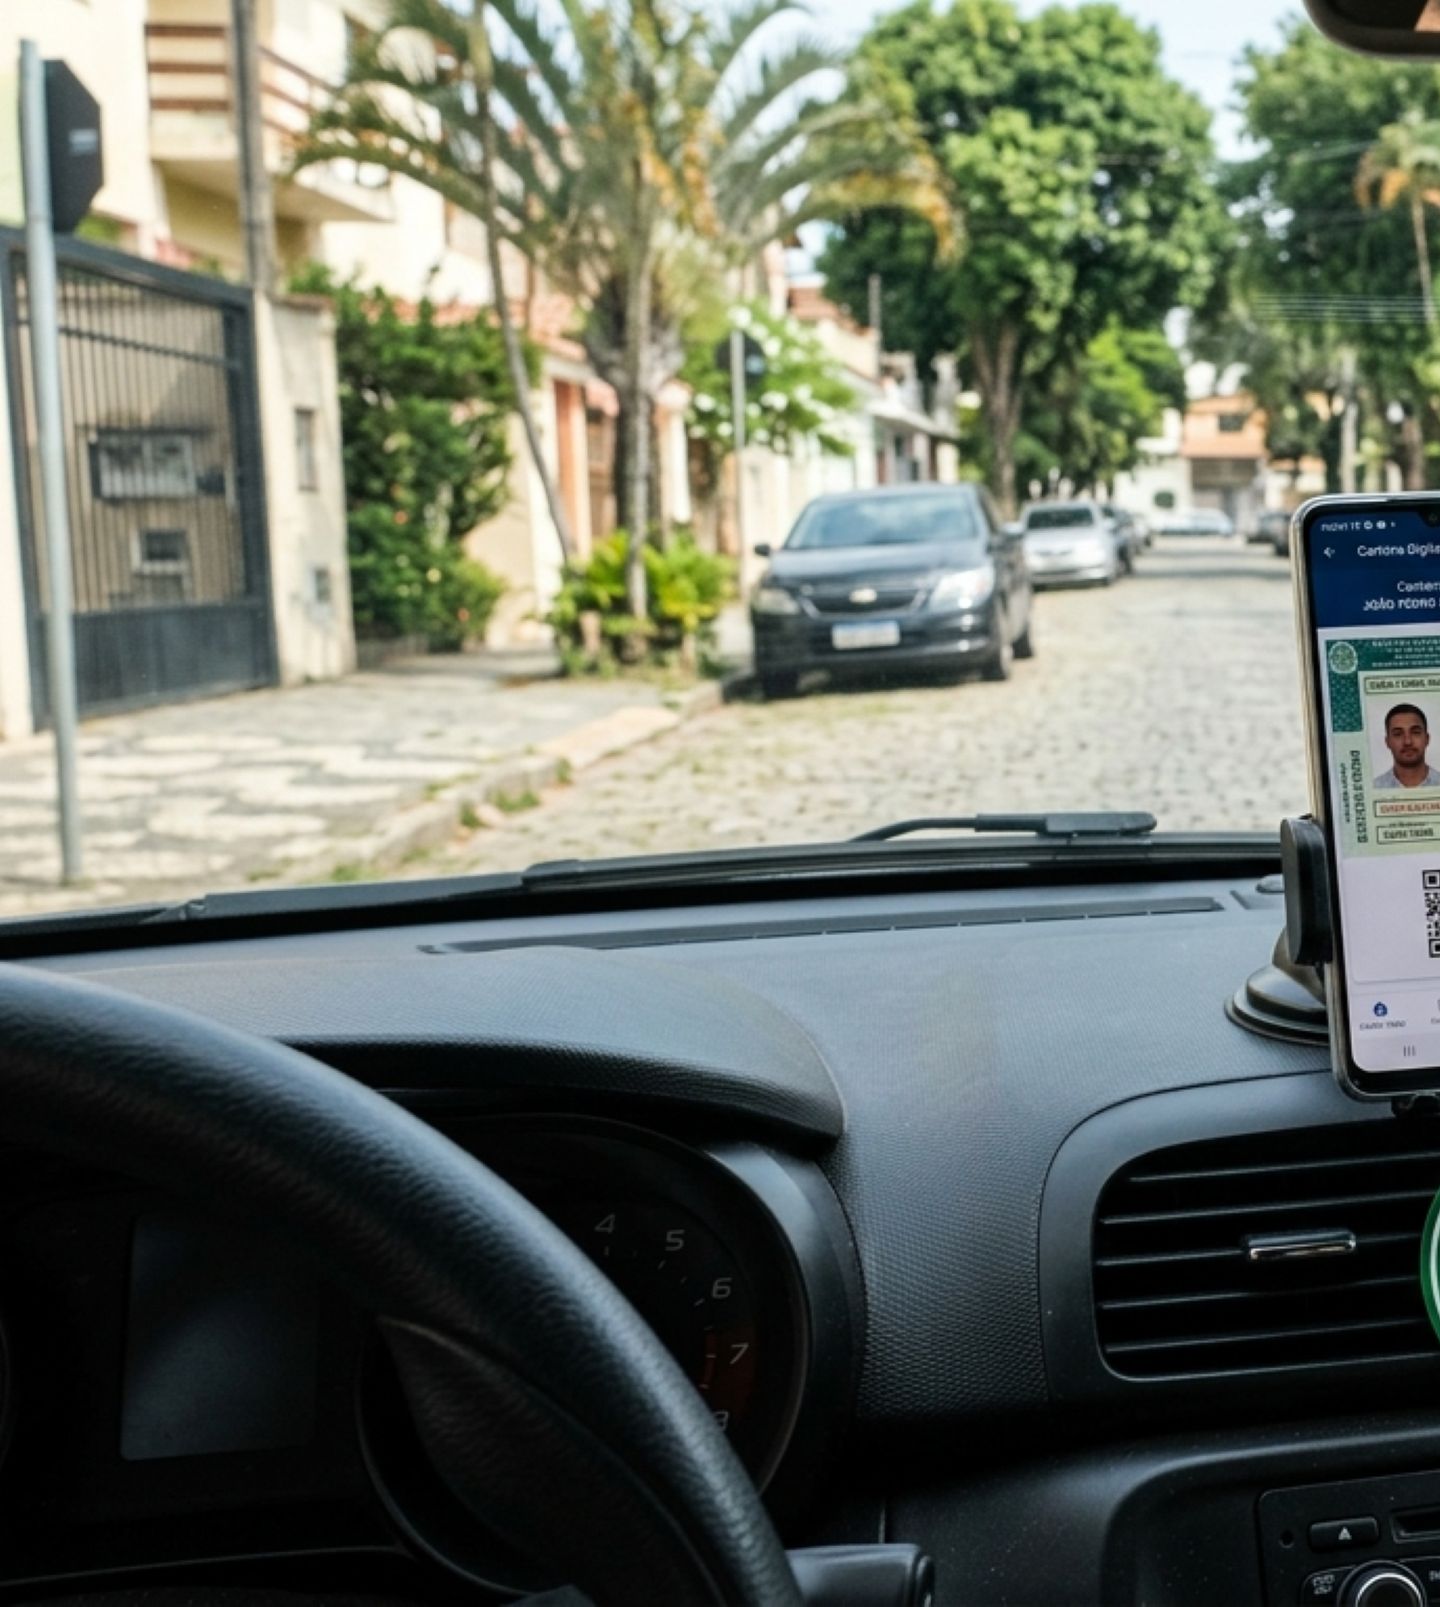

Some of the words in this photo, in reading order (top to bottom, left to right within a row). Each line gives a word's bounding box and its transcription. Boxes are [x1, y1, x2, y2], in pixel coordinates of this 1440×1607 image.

[594, 1214, 617, 1234] 4
[665, 1230, 686, 1251] 5
[711, 1277, 733, 1298] 6
[728, 1343, 749, 1365] 7
